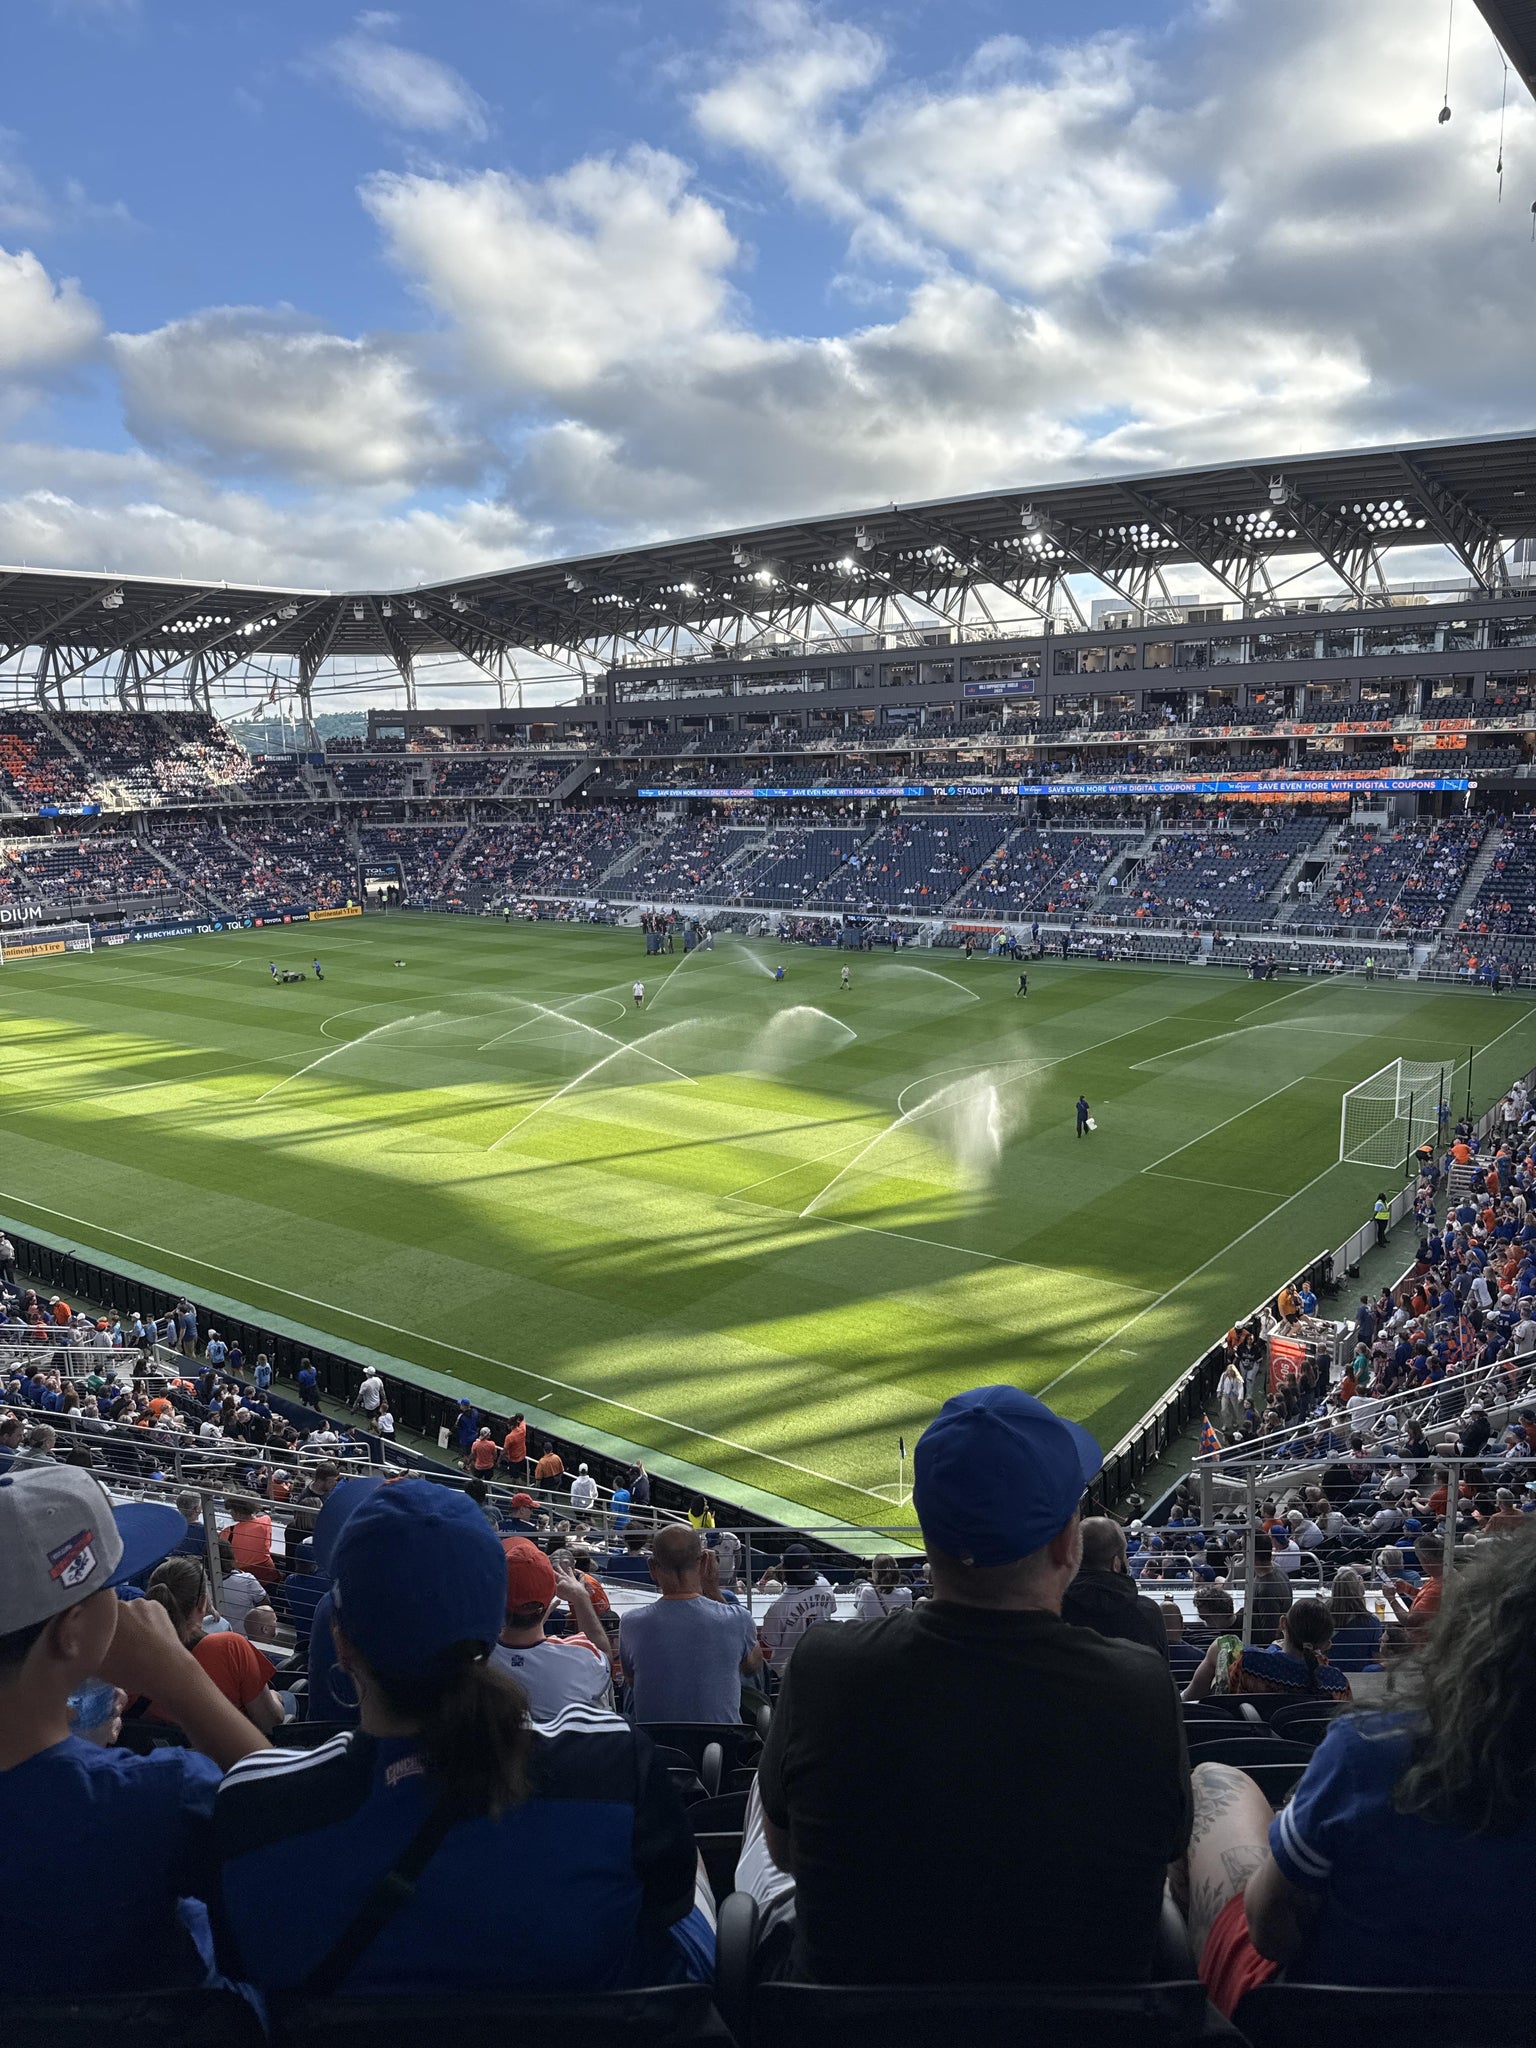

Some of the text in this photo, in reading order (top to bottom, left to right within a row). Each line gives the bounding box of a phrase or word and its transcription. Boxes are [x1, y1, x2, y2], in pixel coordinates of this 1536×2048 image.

[314, 910, 342, 919] Continental
[196, 925, 214, 934] TQL
[226, 921, 244, 930] TQL
[143, 928, 192, 939] MERCYHEALTH
[2, 947, 38, 956] ontinental
